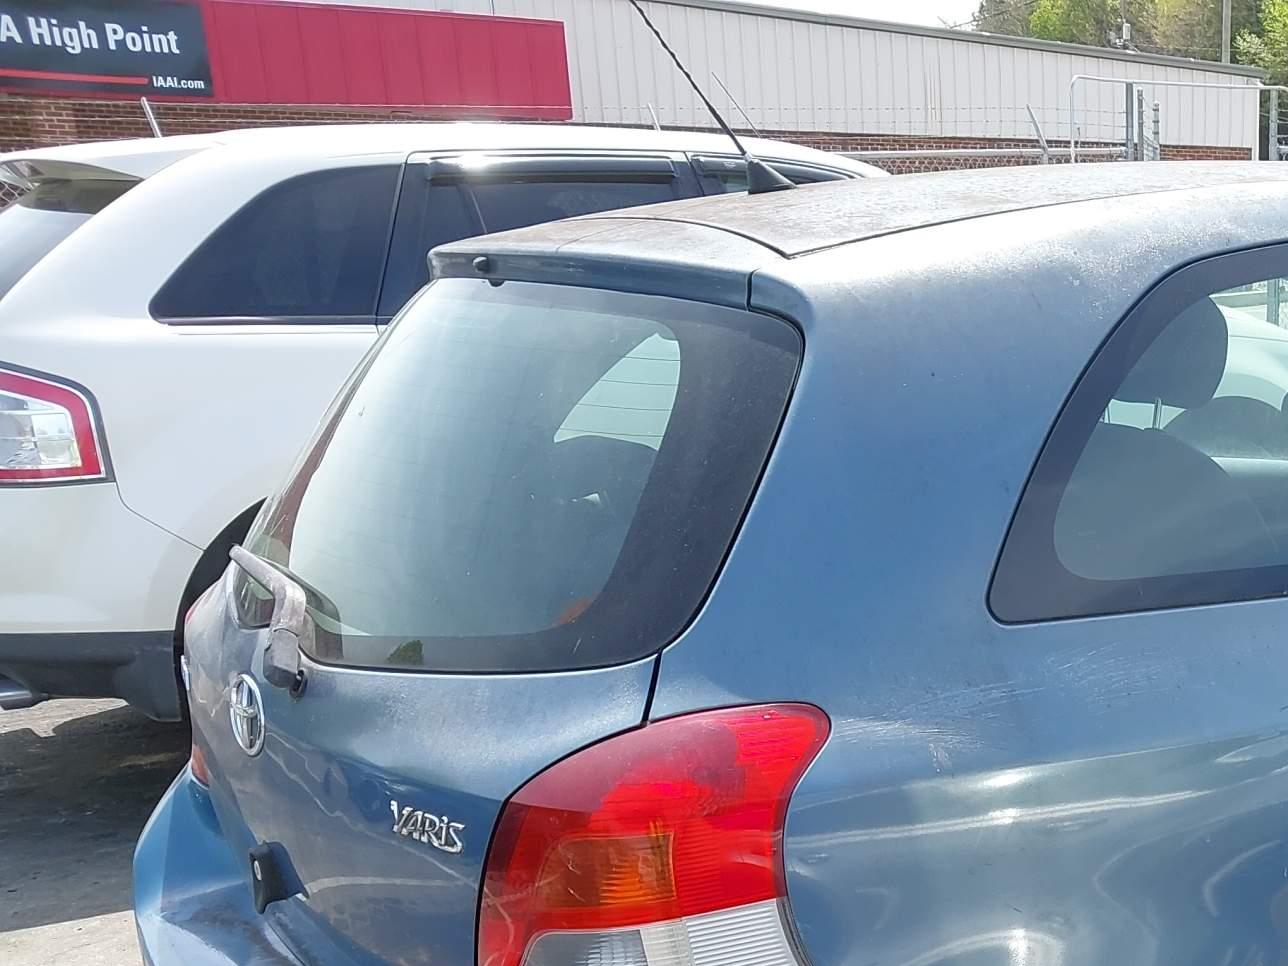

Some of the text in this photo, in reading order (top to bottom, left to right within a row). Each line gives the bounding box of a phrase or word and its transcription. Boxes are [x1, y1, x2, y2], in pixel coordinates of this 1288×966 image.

[27, 16, 99, 54] High
[104, 22, 180, 54] Point
[152, 75, 205, 89] IAAI.com
